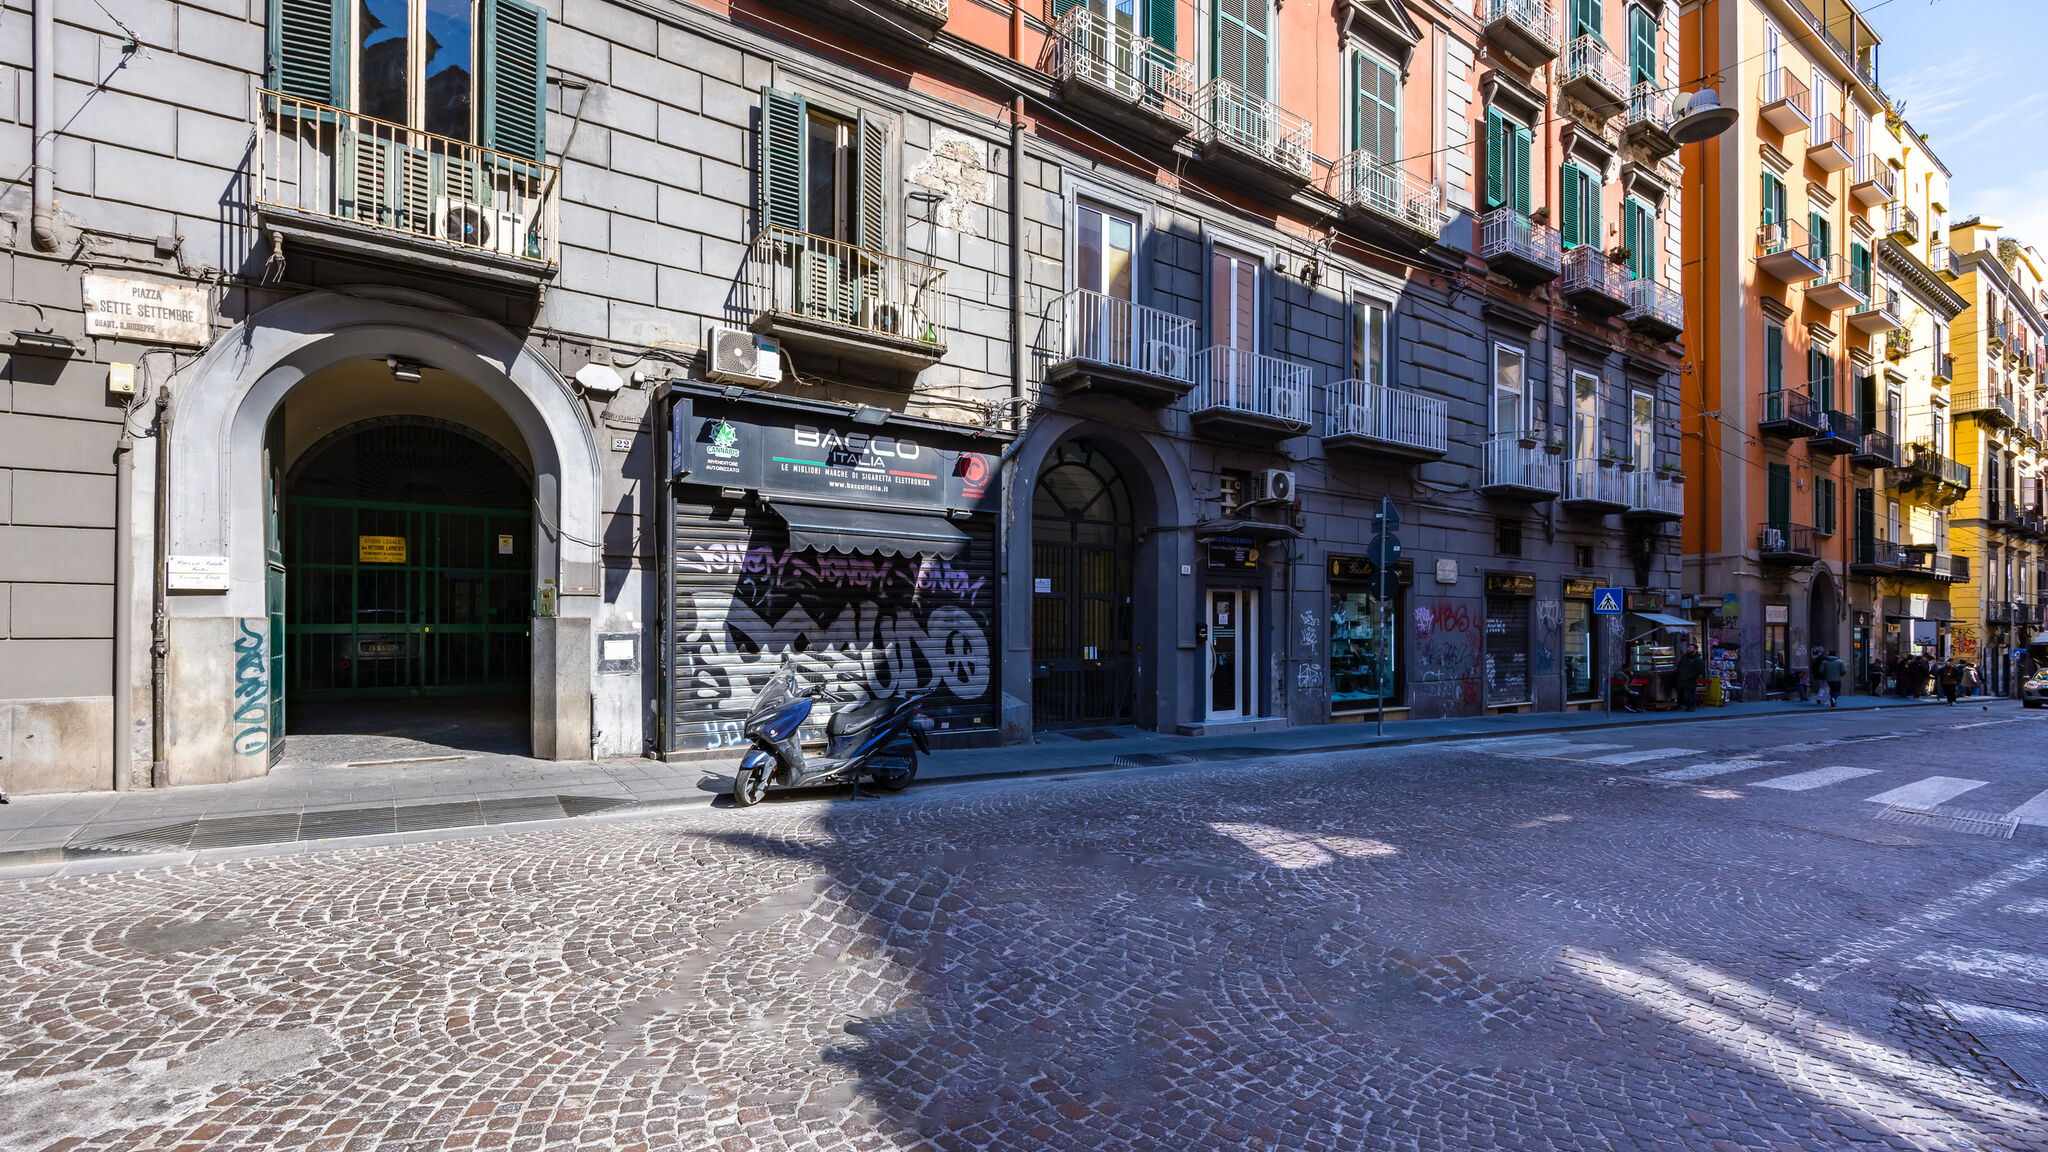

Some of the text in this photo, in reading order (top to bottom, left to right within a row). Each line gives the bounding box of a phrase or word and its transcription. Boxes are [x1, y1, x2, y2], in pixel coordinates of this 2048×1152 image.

[132, 287, 162, 300] PIAZZA
[100, 300, 194, 322] SETTE SETTEMBRE
[616, 439, 630, 449] 22
[794, 424, 920, 460] BACCO
[707, 446, 740, 457] CANNABIS
[833, 451, 885, 468] ITALIA
[781, 463, 930, 487] LE MIGLIORI MARCHE DI SIGARETTA ELETTRONICA
[829, 481, 889, 493] www.baccoitalia.it
